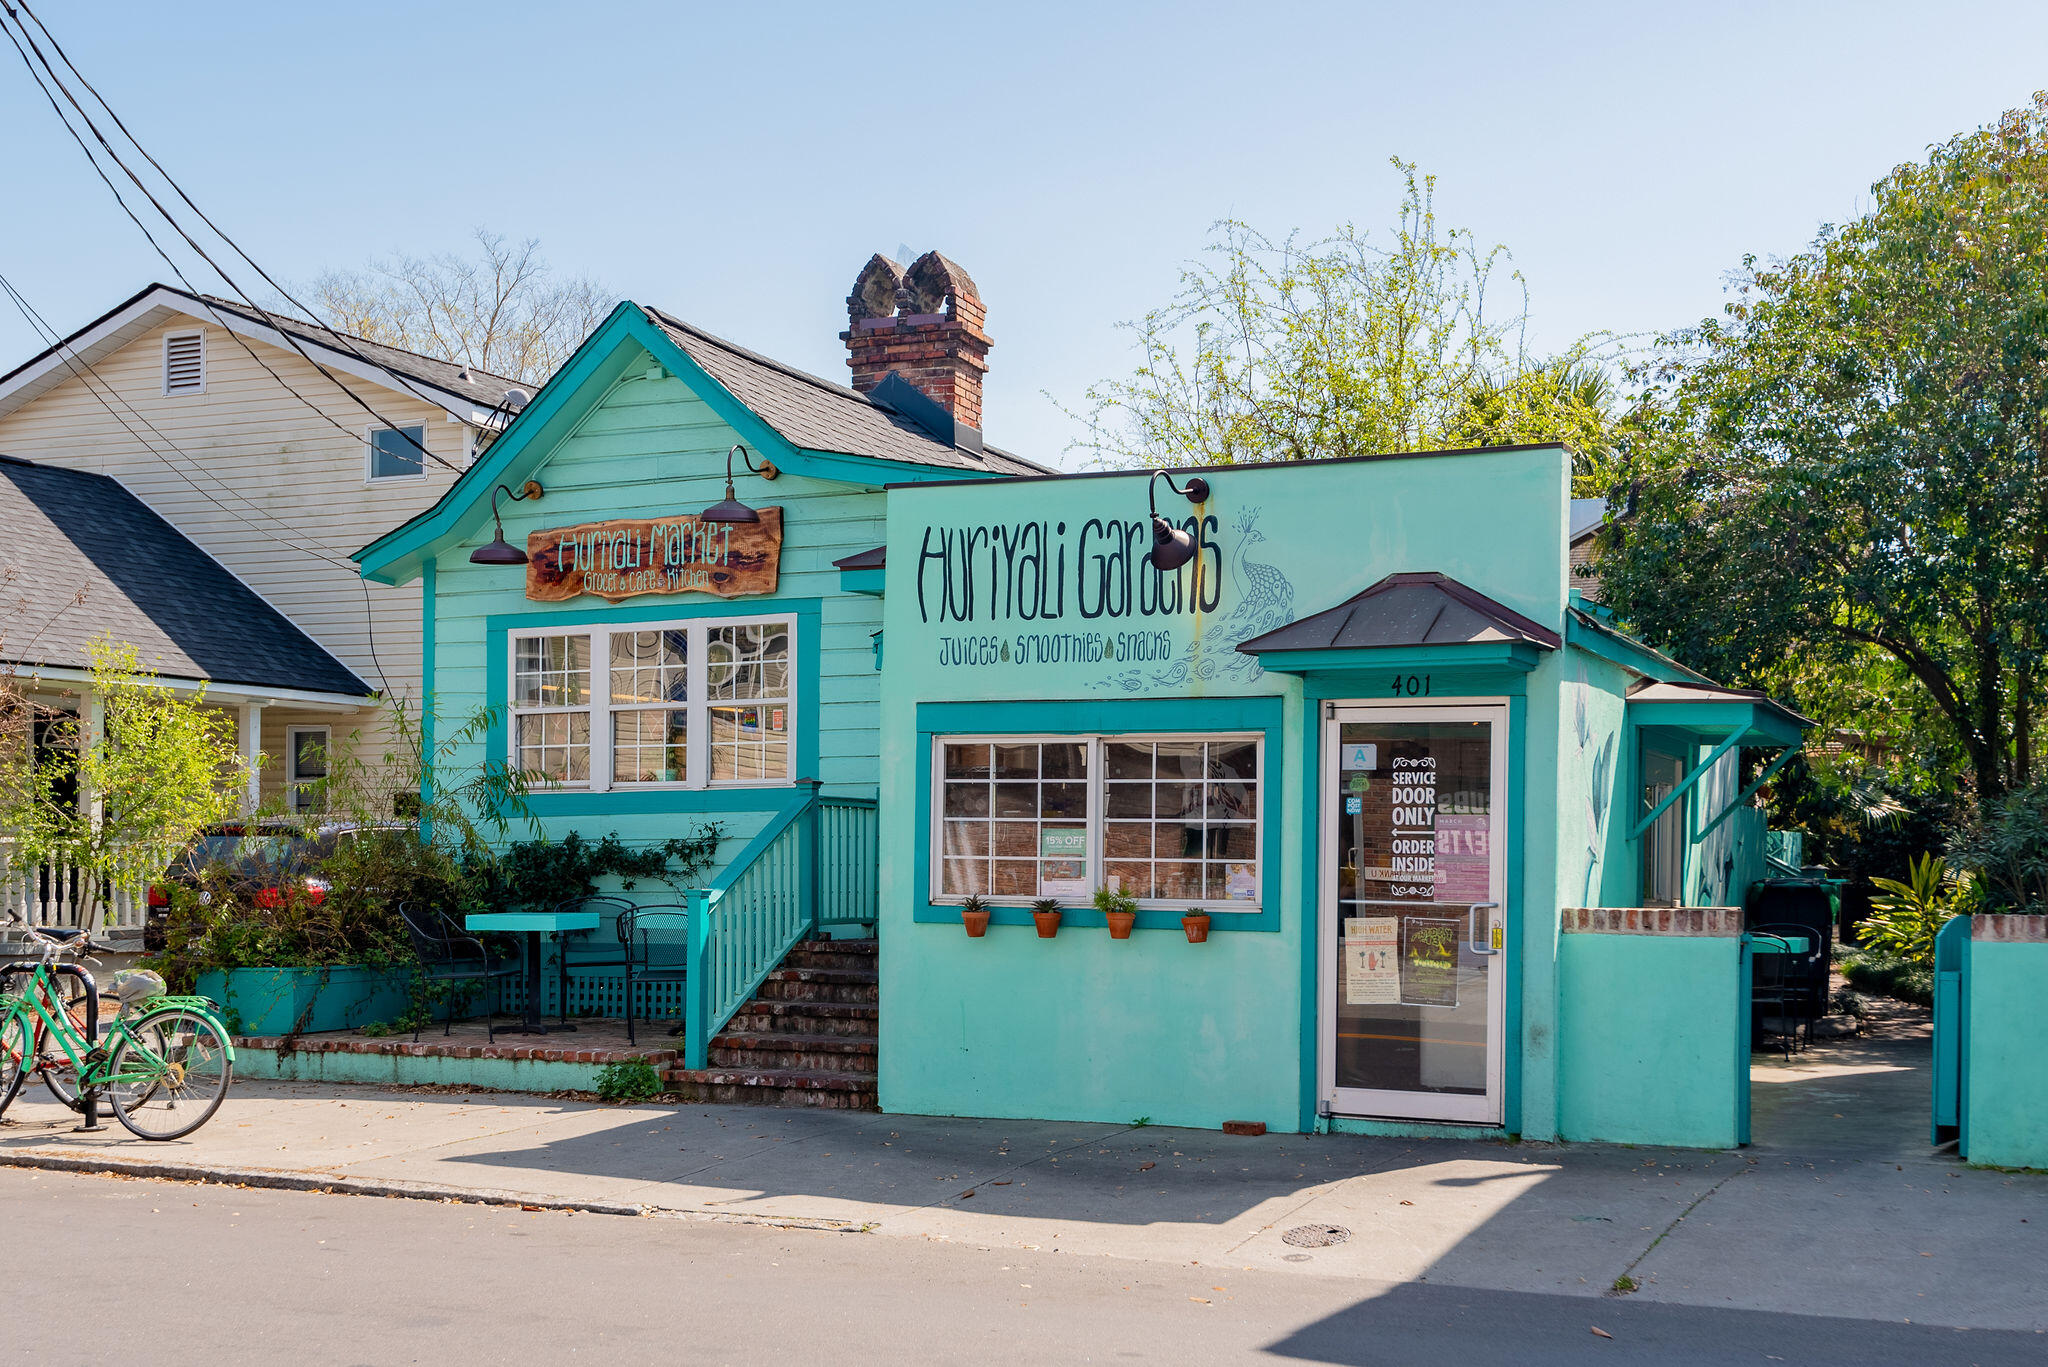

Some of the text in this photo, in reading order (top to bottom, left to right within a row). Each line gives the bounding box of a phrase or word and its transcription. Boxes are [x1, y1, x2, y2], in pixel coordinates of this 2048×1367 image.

[1391, 674, 1430, 697] 401
[1353, 749, 1366, 762] A
[1392, 771, 1436, 785] SERVICE
[1392, 787, 1436, 805] DOOR
[1392, 807, 1435, 826] ONLY
[1046, 835, 1086, 846] 15% OFF
[1392, 839, 1435, 855] ORDER
[1391, 856, 1435, 873] INSIDE
[1369, 925, 1393, 934] WATER
